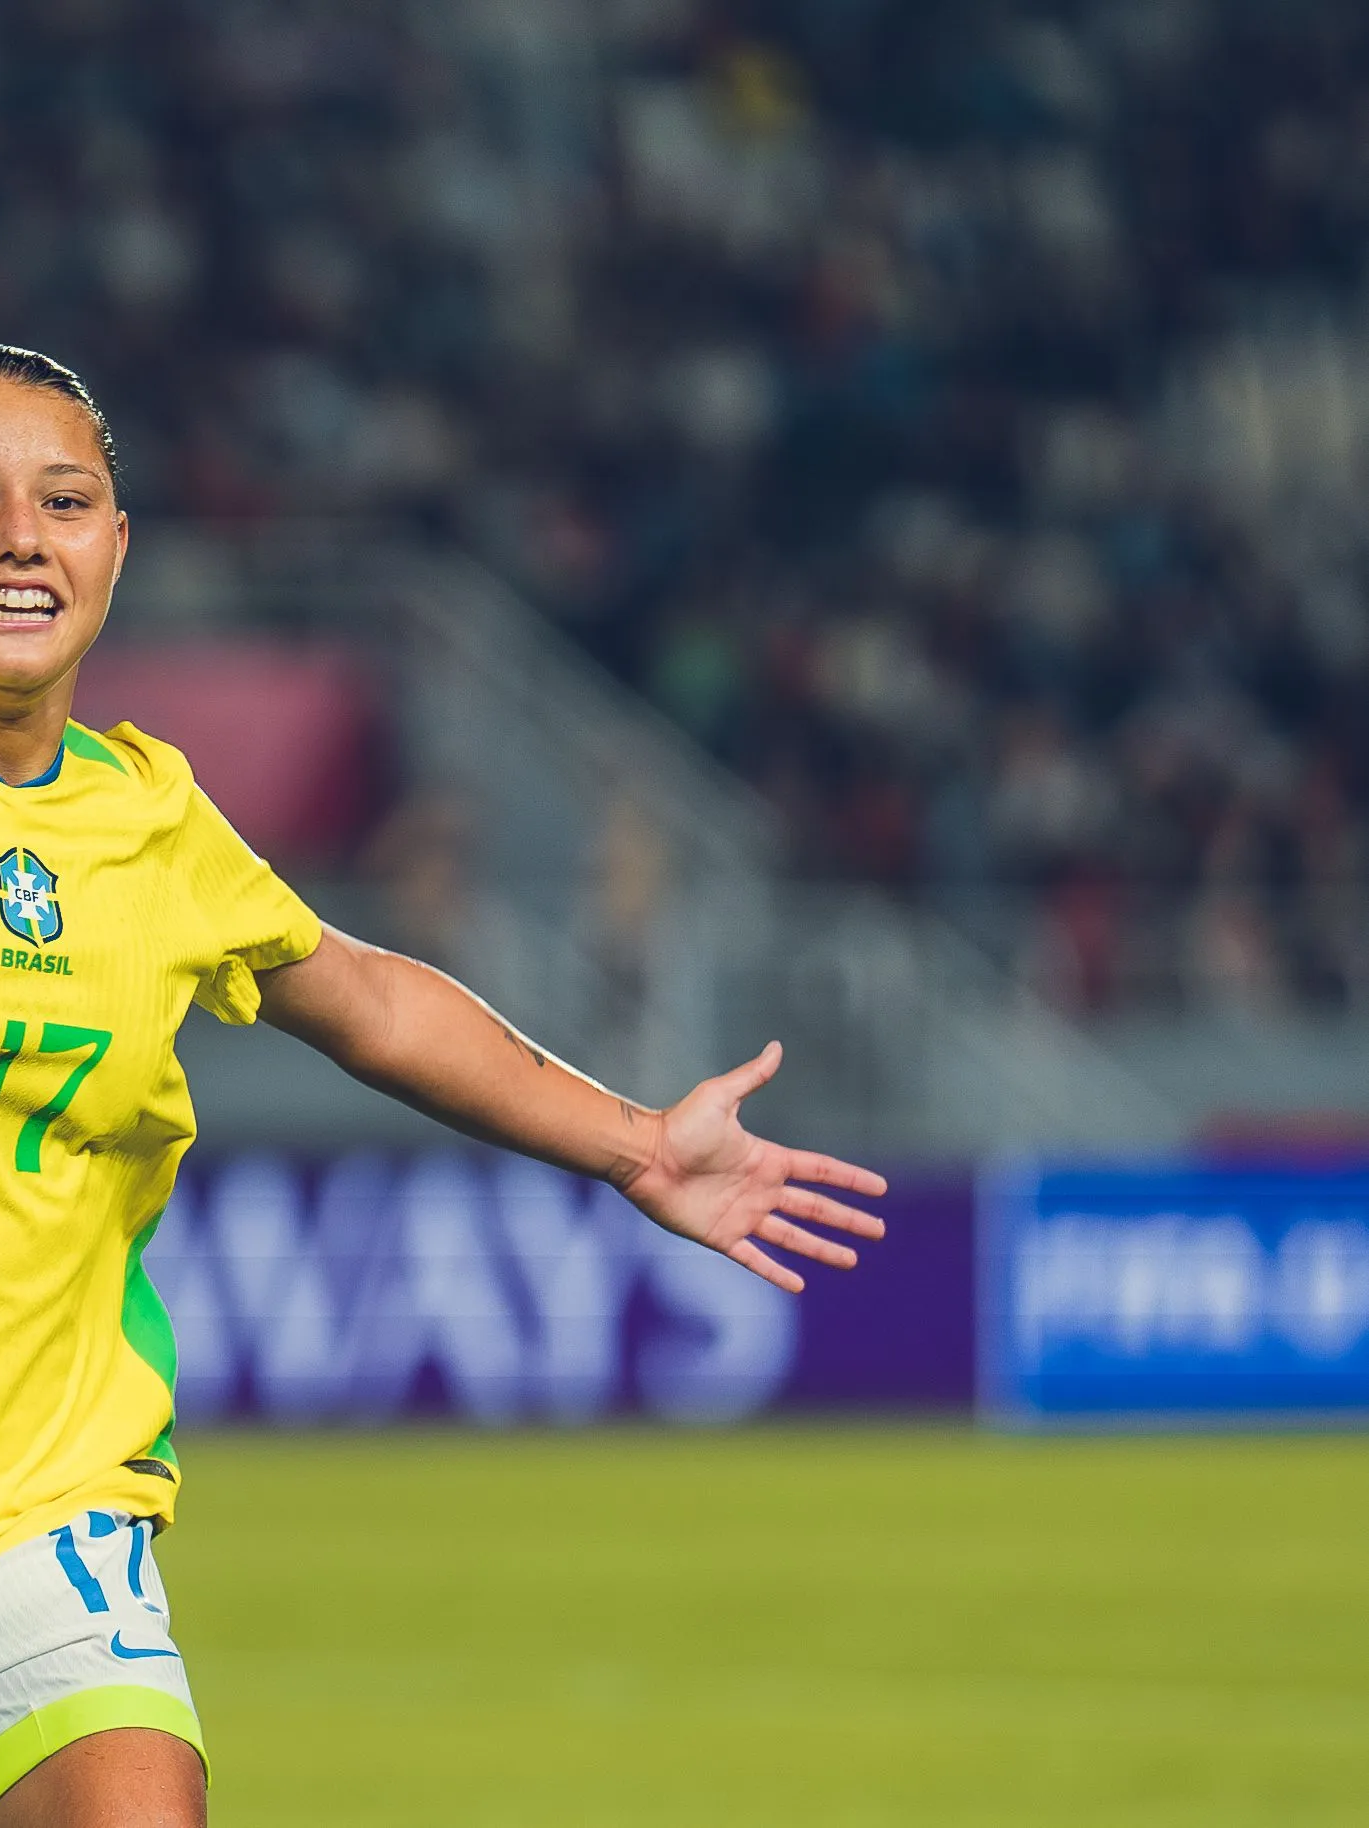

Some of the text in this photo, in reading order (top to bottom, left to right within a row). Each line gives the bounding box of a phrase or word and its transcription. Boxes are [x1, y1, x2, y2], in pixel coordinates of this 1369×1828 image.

[15, 888, 39, 902] CBF
[1, 948, 73, 976] BRASIL
[147, 1142, 799, 1428] WAYS
